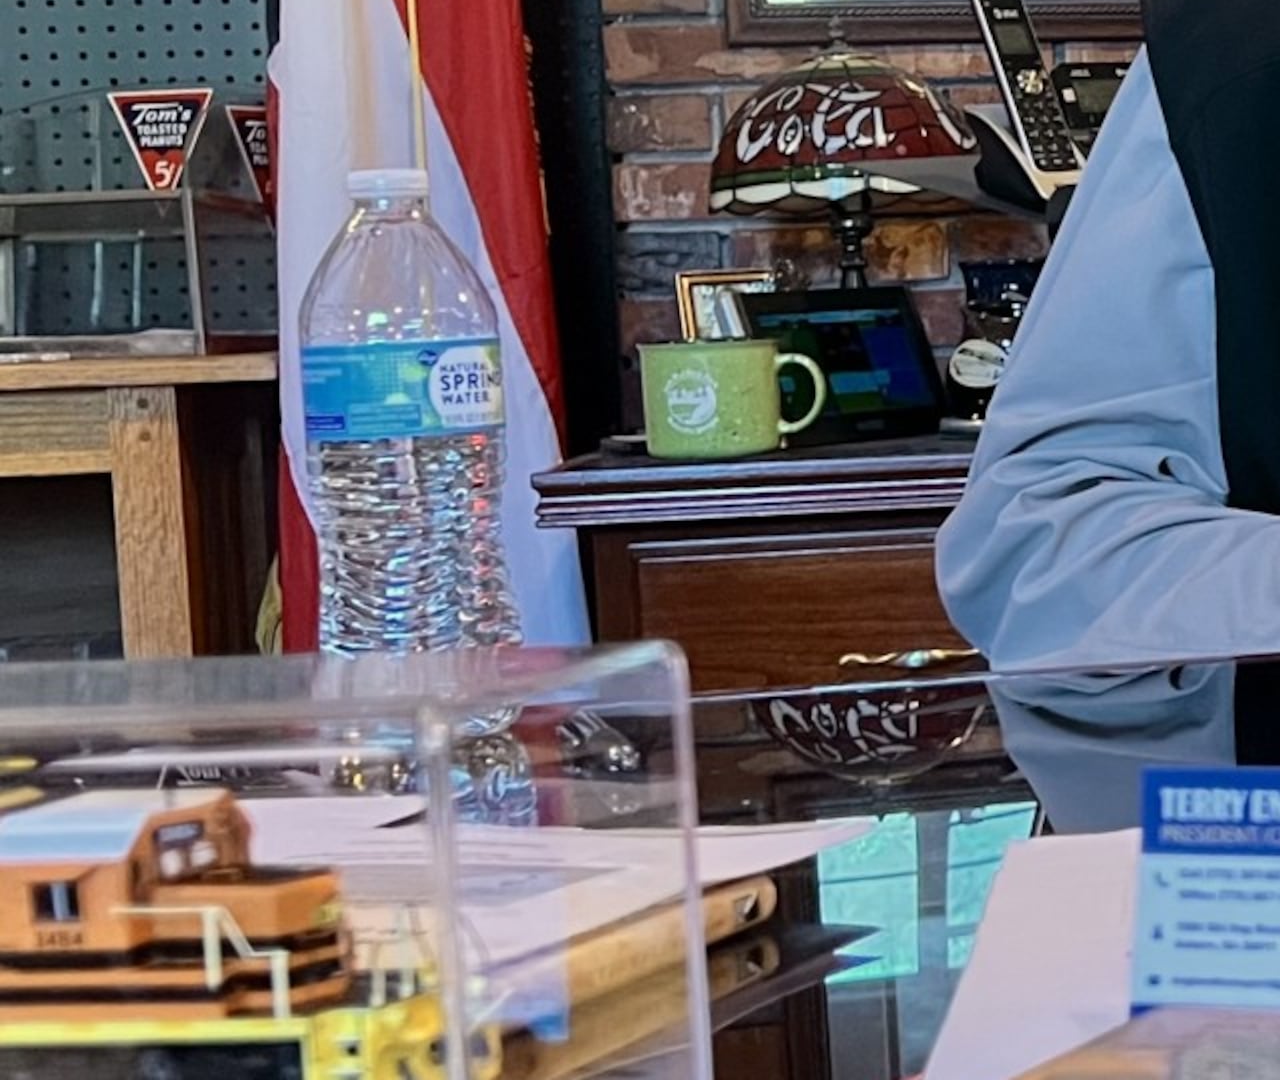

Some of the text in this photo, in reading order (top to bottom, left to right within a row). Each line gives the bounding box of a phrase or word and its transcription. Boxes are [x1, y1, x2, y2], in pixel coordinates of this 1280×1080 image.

[131, 102, 192, 126] Tom's
[137, 123, 188, 136] TOASTED
[140, 135, 183, 147] PEANUTS
[1159, 786, 1249, 823] TERRY
